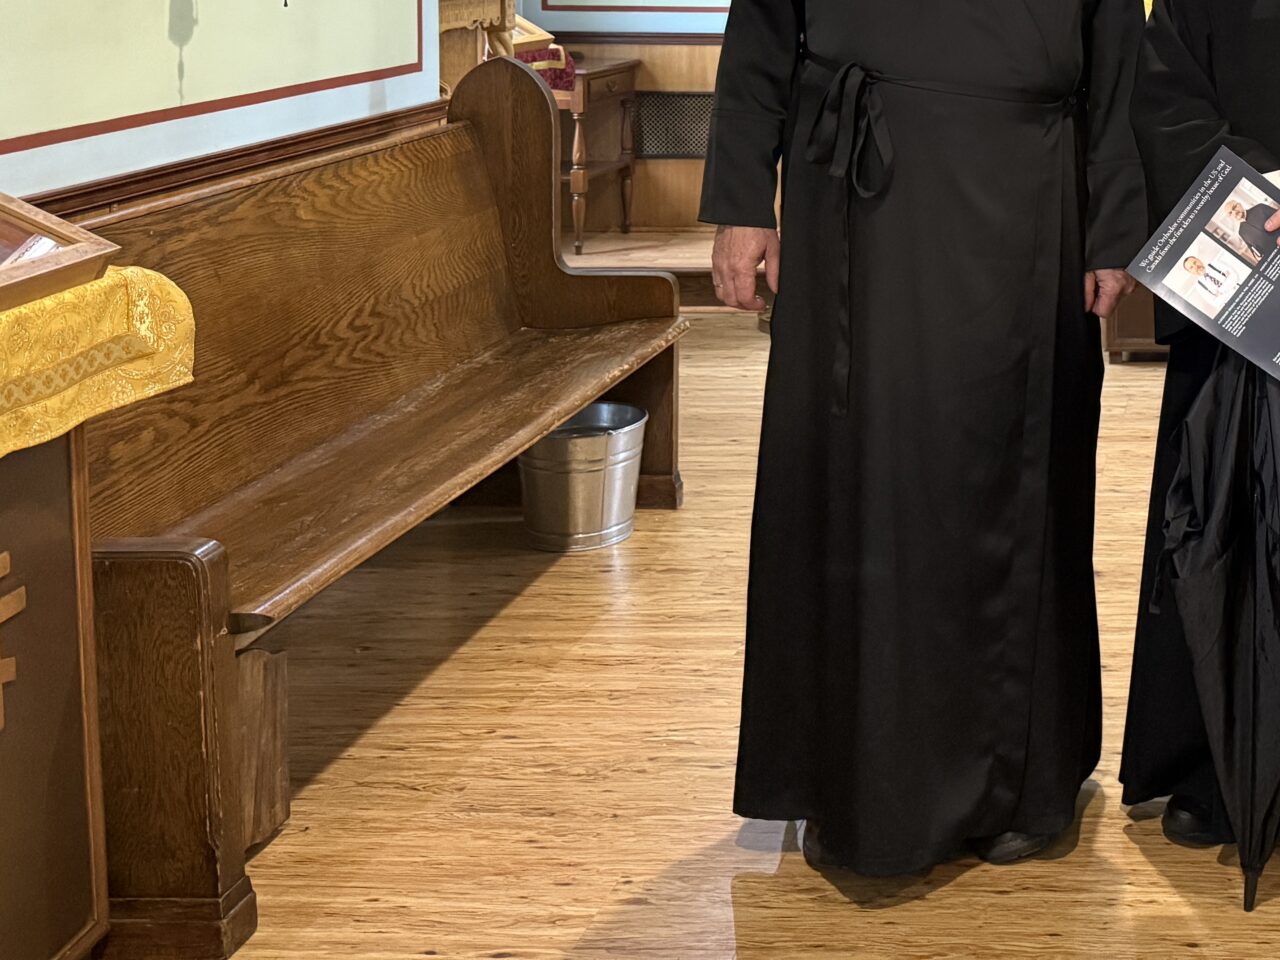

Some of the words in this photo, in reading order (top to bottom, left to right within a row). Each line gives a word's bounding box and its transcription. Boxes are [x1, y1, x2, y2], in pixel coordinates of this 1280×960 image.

[1139, 258, 1150, 269] We
[1146, 244, 1162, 262] guide
[1156, 221, 1179, 247] Orthodox
[1175, 192, 1202, 224] communities
[1202, 177, 1213, 188] the
[1209, 169, 1219, 180] US
[1215, 160, 1226, 172] and
[1145, 254, 1163, 274] Canada
[1158, 243, 1172, 257] from
[1167, 235, 1178, 246] the
[1194, 193, 1213, 213] worthy
[1206, 180, 1220, 196] house
